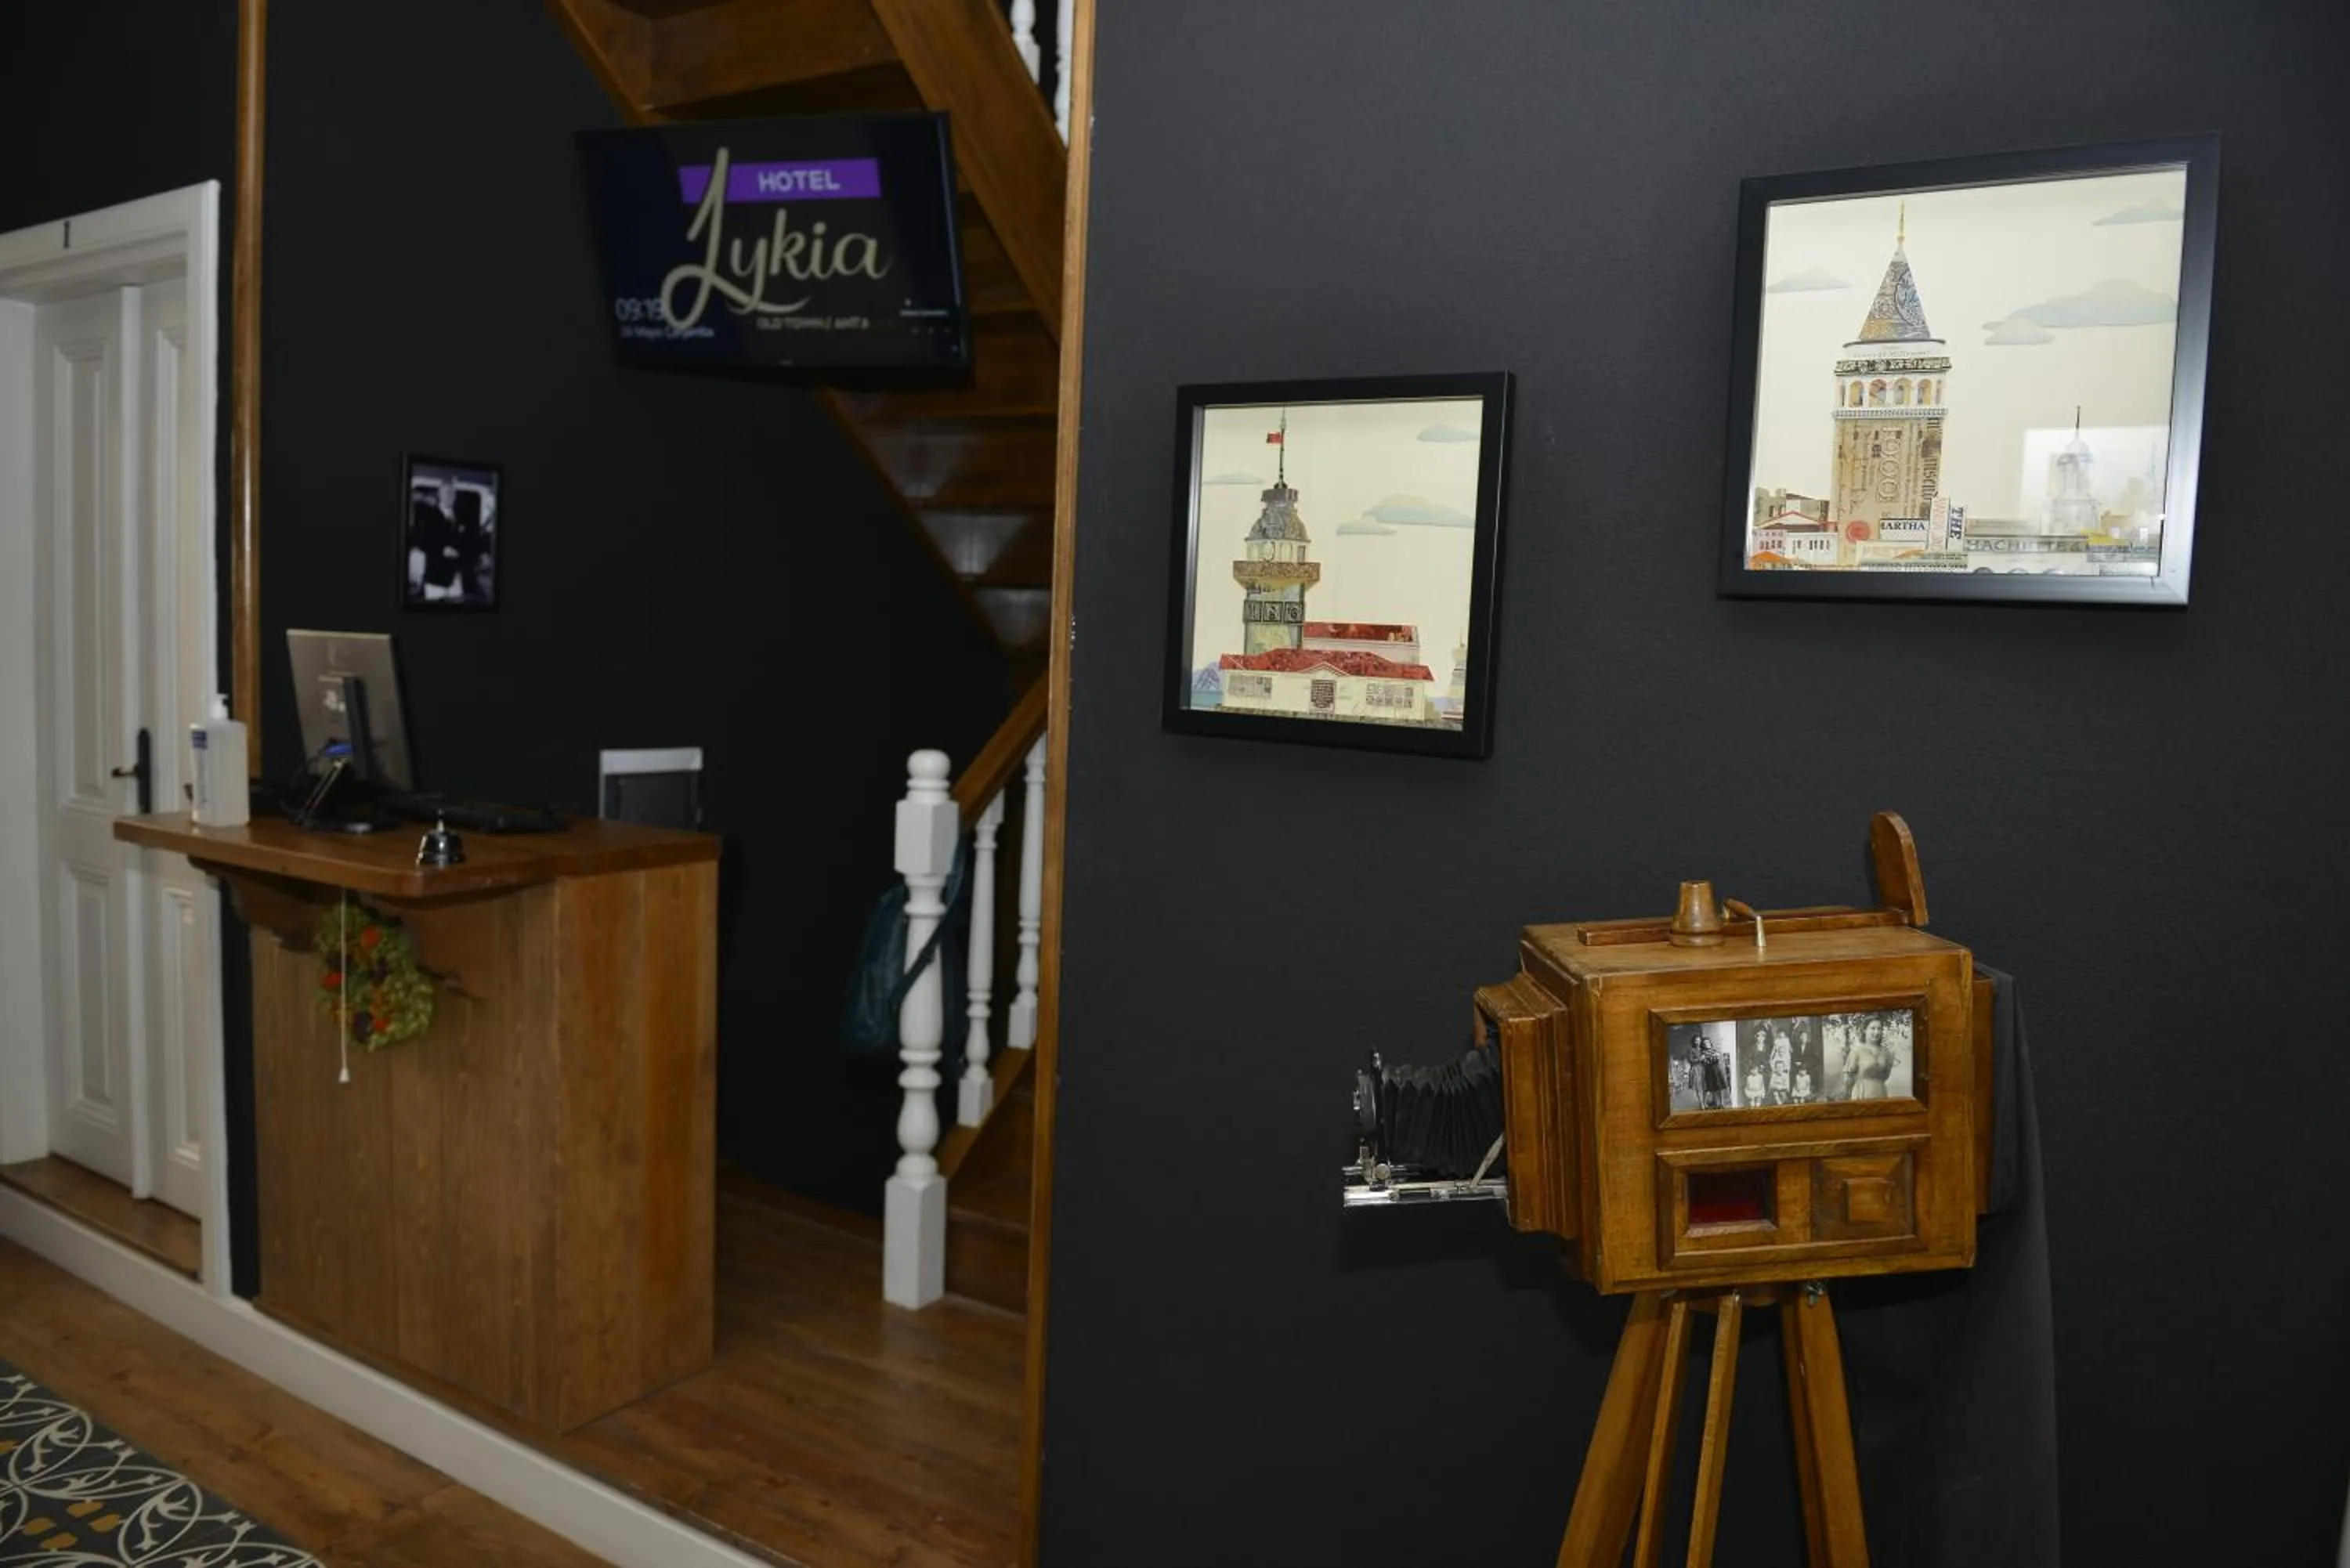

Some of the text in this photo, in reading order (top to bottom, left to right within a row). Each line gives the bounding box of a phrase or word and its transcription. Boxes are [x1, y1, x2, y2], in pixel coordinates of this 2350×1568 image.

[757, 170, 841, 193] HOTEL
[660, 146, 892, 330] Lykia
[1950, 507, 1964, 540] THE
